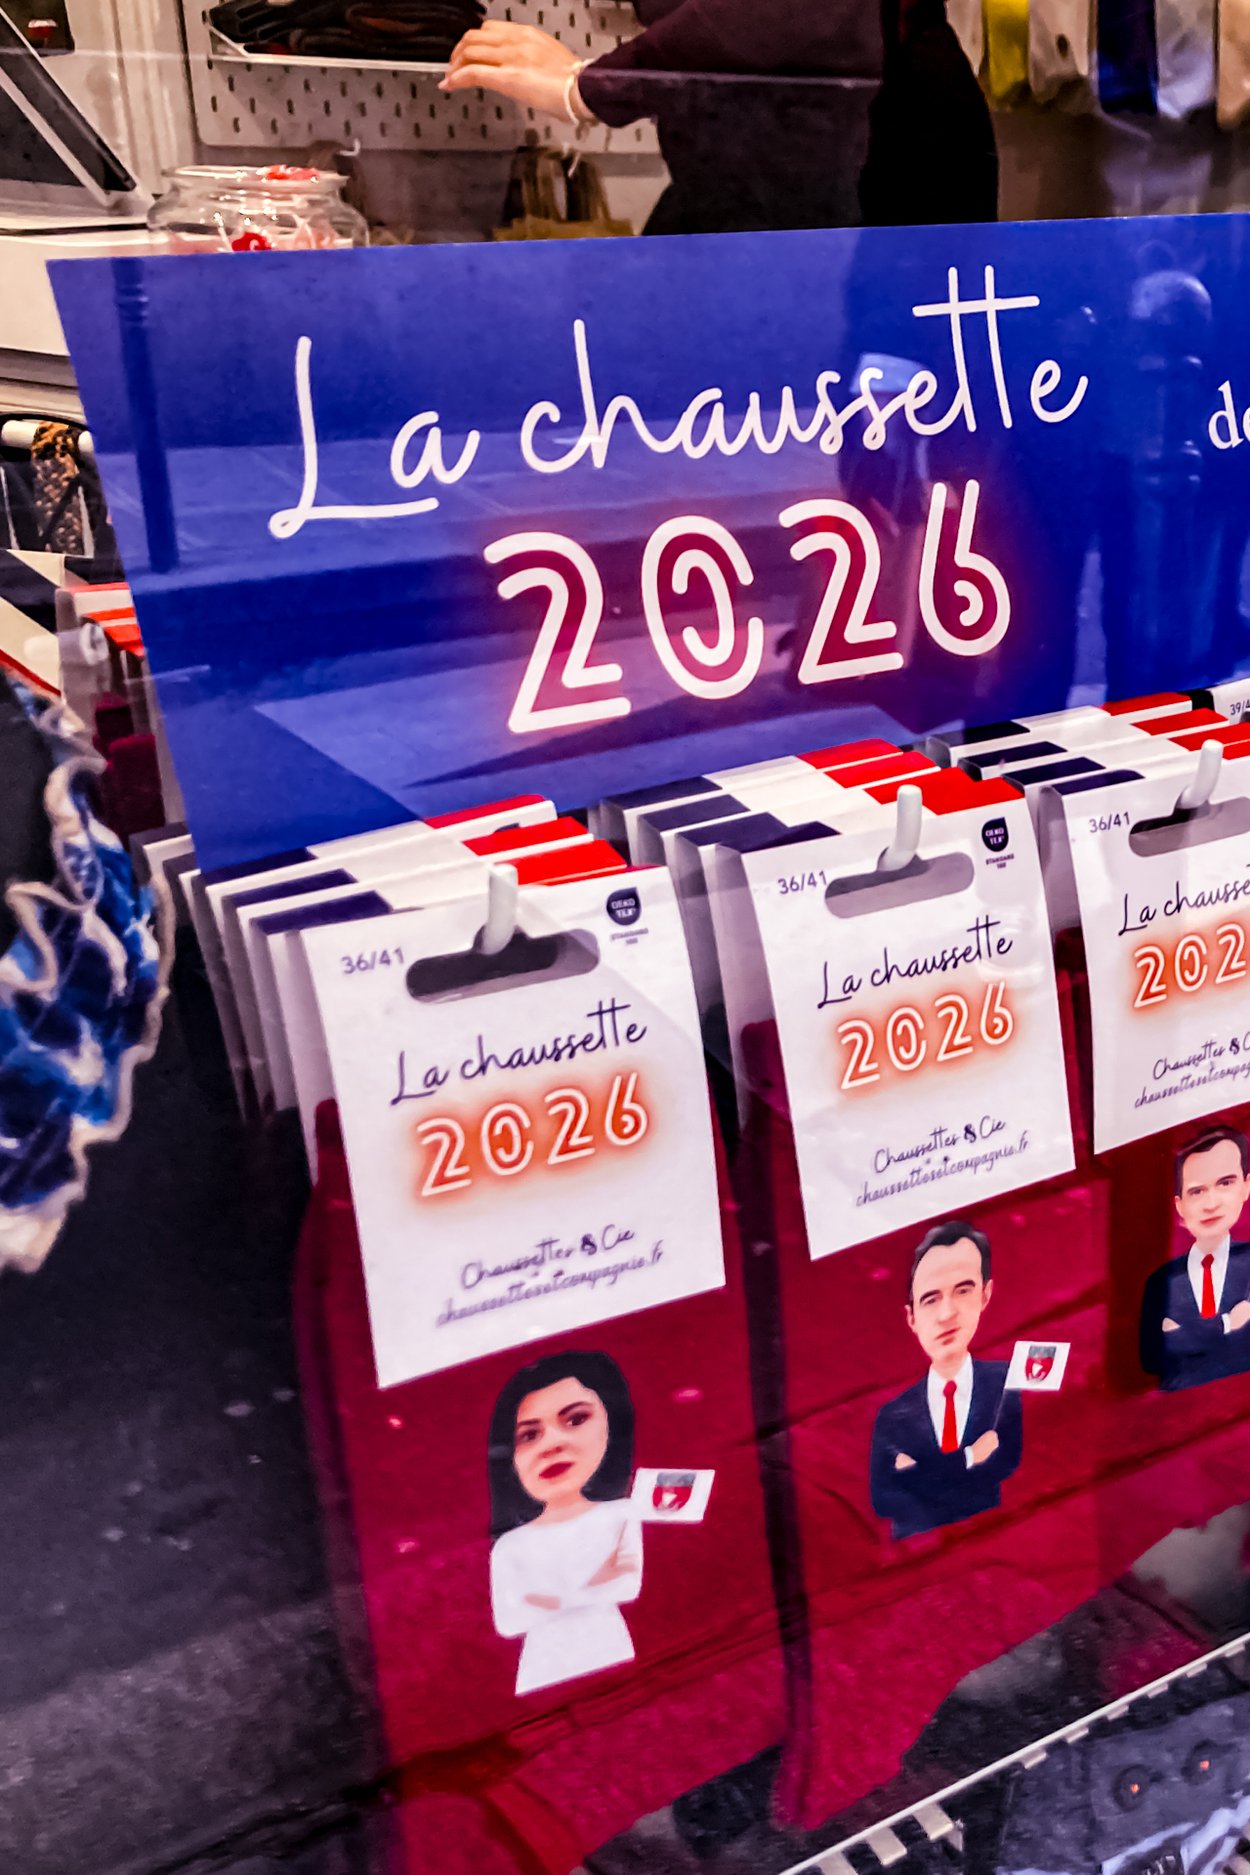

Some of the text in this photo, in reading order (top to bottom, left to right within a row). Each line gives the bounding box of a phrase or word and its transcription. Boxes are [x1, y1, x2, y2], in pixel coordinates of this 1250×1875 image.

[269, 264, 1089, 539] La chaussette
[484, 479, 1011, 734] 2026
[1089, 811, 1131, 833] 36/41
[777, 871, 828, 894] 36/41
[1117, 894, 1156, 937] La
[341, 948, 405, 975] 36/41
[817, 915, 1013, 1009] La chaussette
[390, 998, 647, 1106] La chaussette
[836, 981, 1014, 1090] 2026
[1228, 1037, 1240, 1054] &
[416, 1072, 648, 1197] 2026
[874, 1116, 1007, 1174] Chaussettes & Cie
[580, 1233, 598, 1255] &
